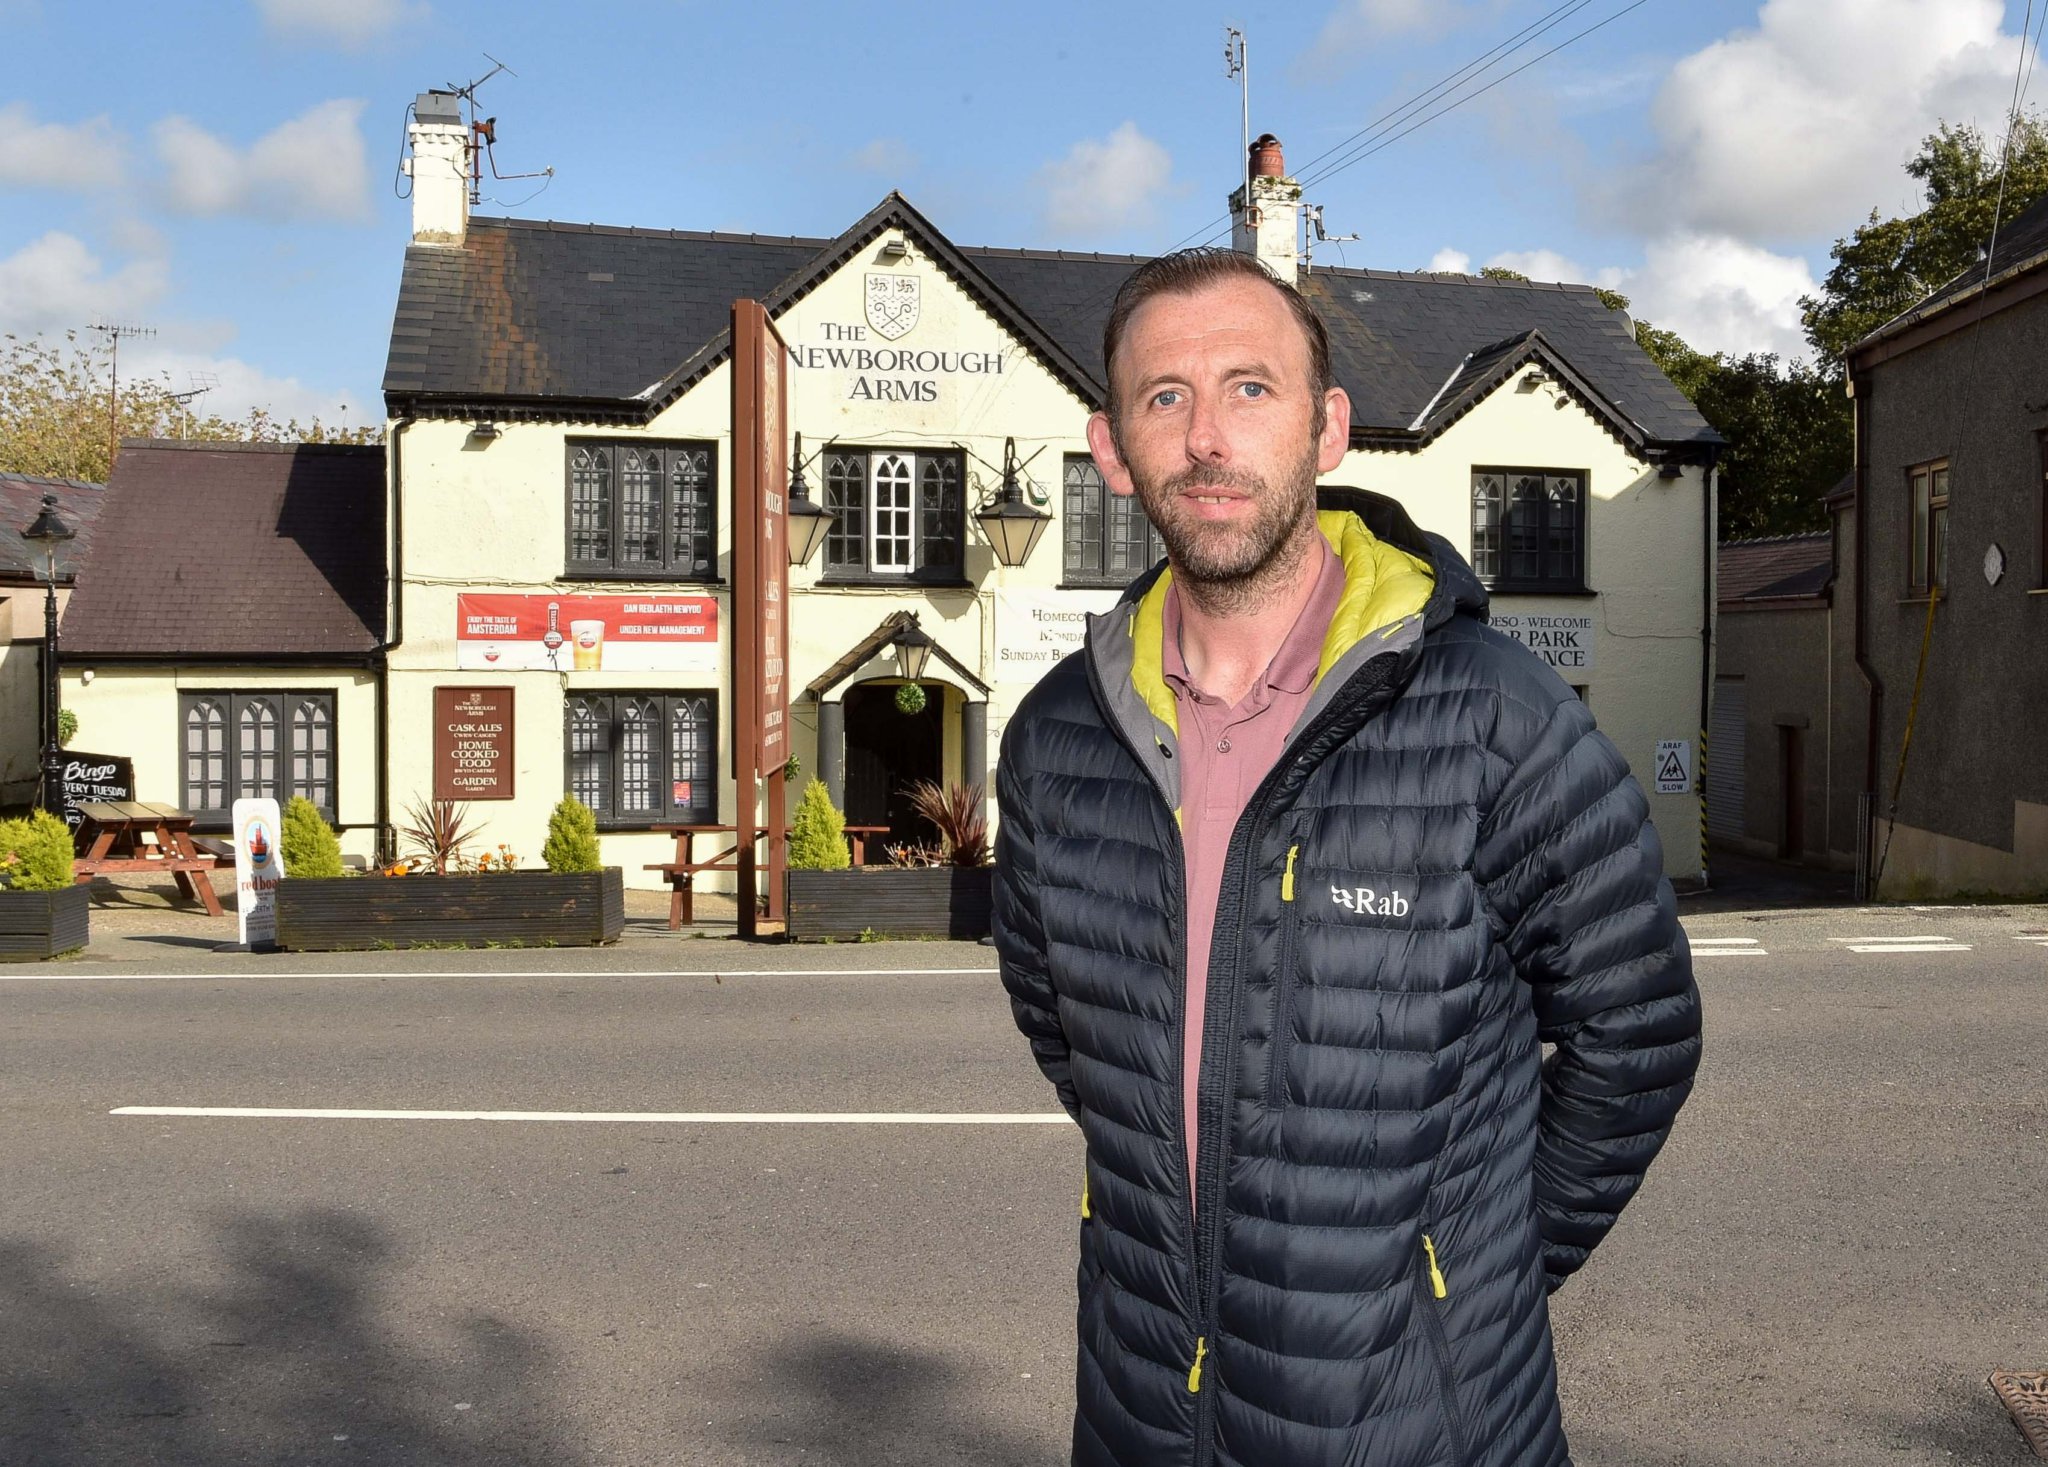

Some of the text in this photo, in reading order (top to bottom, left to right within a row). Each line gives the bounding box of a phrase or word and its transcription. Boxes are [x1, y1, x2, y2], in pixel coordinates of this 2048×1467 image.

[820, 322, 867, 342] THE
[848, 375, 938, 402] ARMS
[623, 604, 638, 614] DAN
[483, 615, 493, 623] THE
[1032, 609, 1085, 622] HOMECO
[1527, 617, 1591, 628] WELCOME
[466, 623, 518, 635] AMSTERDAM
[619, 625, 705, 635] UNDER NEW MANAGEMENT
[1528, 630, 1579, 648] PARK
[1001, 648, 1048, 661] SUNDAY
[448, 723, 503, 732] CASK ALES
[458, 741, 493, 750] HOME
[451, 750, 499, 759] COOKED
[459, 758, 492, 768] FOOD
[63, 760, 117, 781] Bingo
[453, 777, 498, 786] GARDEN
[1662, 783, 1683, 791] SLOW
[91, 784, 127, 797] TUESDAY
[241, 875, 258, 891] red
[1353, 887, 1409, 917] Rab
